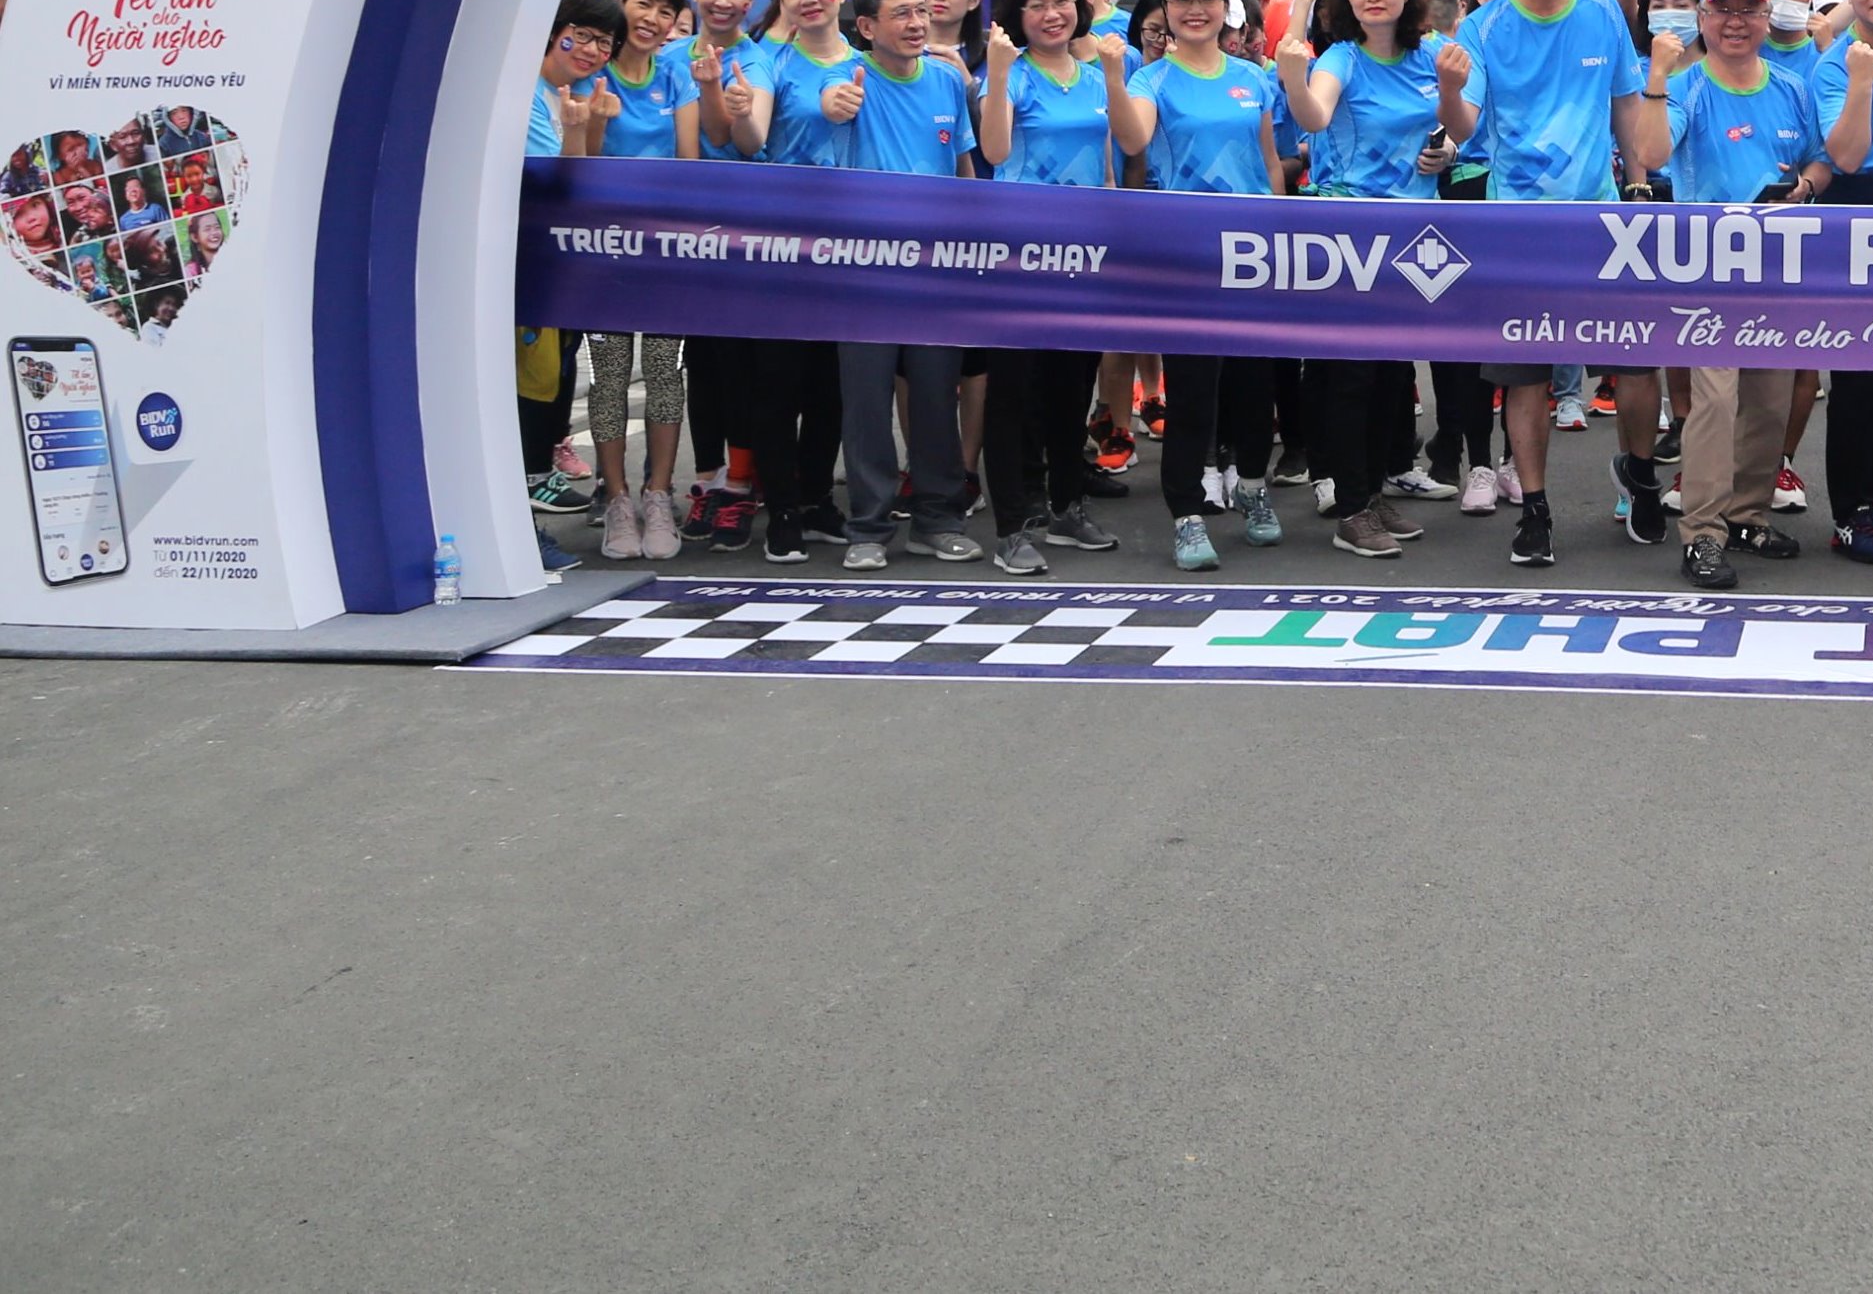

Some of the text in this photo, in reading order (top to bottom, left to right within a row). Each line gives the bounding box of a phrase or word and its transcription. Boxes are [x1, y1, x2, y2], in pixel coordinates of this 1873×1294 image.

[152, 7, 182, 26] cho
[67, 10, 227, 67] Người nghèo
[1582, 57, 1602, 66] BIDV
[50, 71, 246, 89] VÌ MIỀN TRUNG THƯƠNG YÊU
[550, 225, 1108, 279] TRIỆU TRÁI TIM CHUNG NHỊP CHẠY
[1598, 206, 1821, 284] XUẤT
[1219, 231, 1391, 292] BIDV
[1502, 312, 1565, 342] GIẢI
[1575, 319, 1657, 350] CHẠY
[1670, 306, 1724, 348] Tết
[1734, 312, 1788, 349] ấm
[1795, 317, 1854, 351] cho
[140, 410, 167, 425] BIDV
[150, 424, 176, 438] Run
[153, 535, 259, 547] www.bidvrun.com
[170, 551, 247, 563] 01/11/2020
[154, 565, 258, 580] đến 22/11/2020
[935, 590, 1065, 601] TRUNG
[1262, 594, 1381, 606] 2021
[1207, 609, 1746, 664] PHÁT
